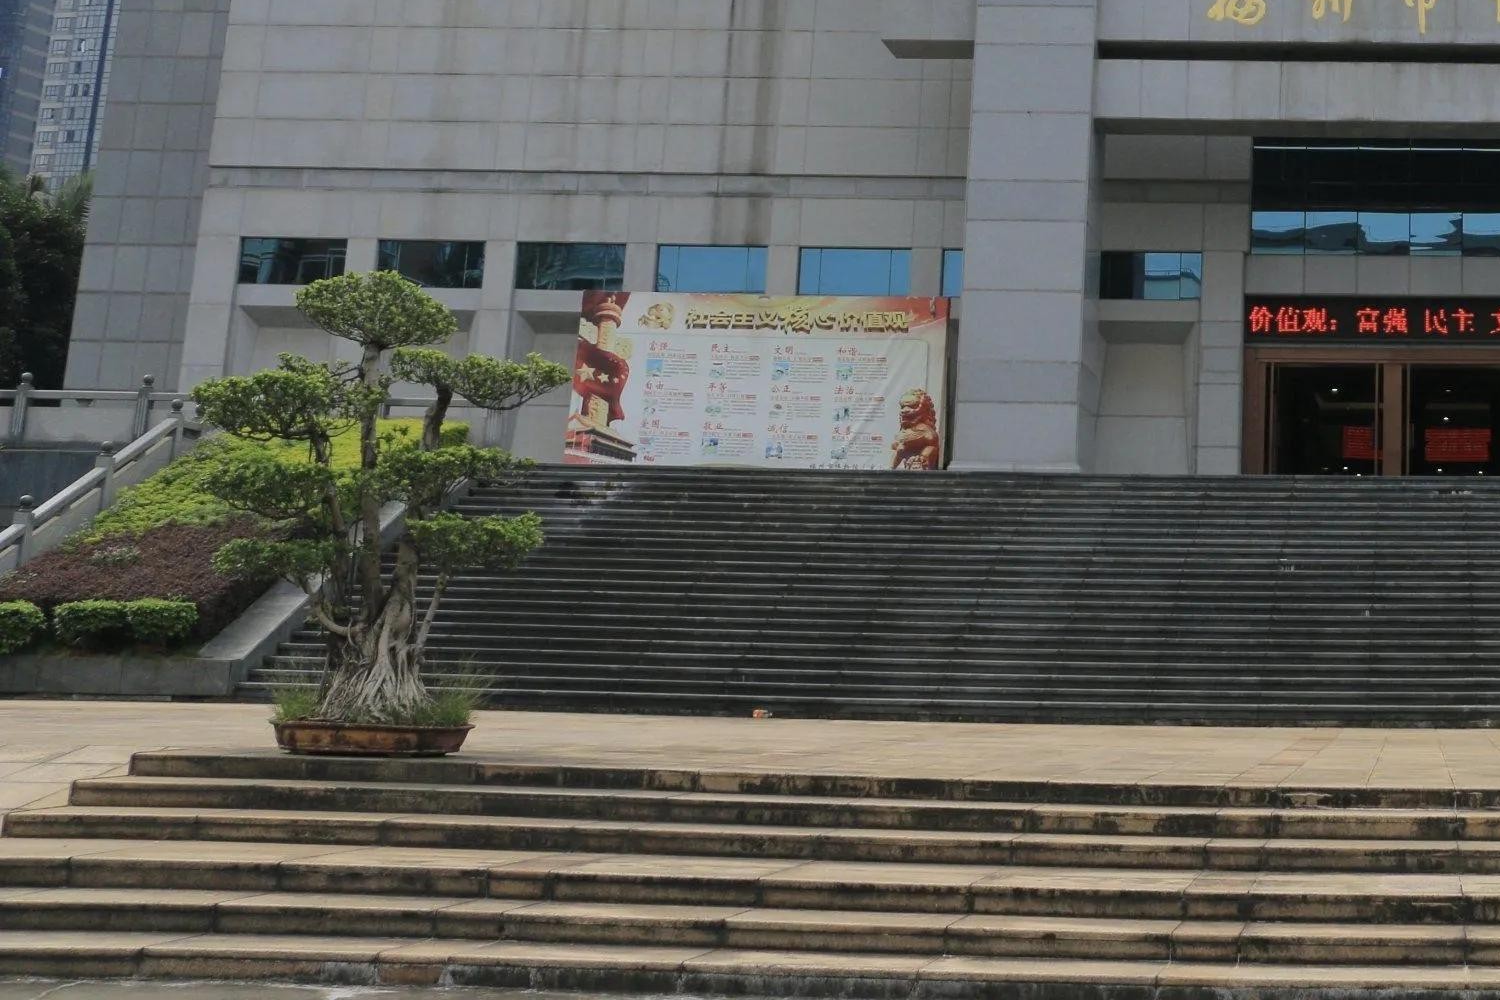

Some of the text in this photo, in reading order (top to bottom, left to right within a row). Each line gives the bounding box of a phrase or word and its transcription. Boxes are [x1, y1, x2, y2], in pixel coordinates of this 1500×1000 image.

[686, 305, 911, 335] 社会主义核心价值观
[1356, 307, 1408, 333] 富强
[1424, 308, 1475, 334] 民主
